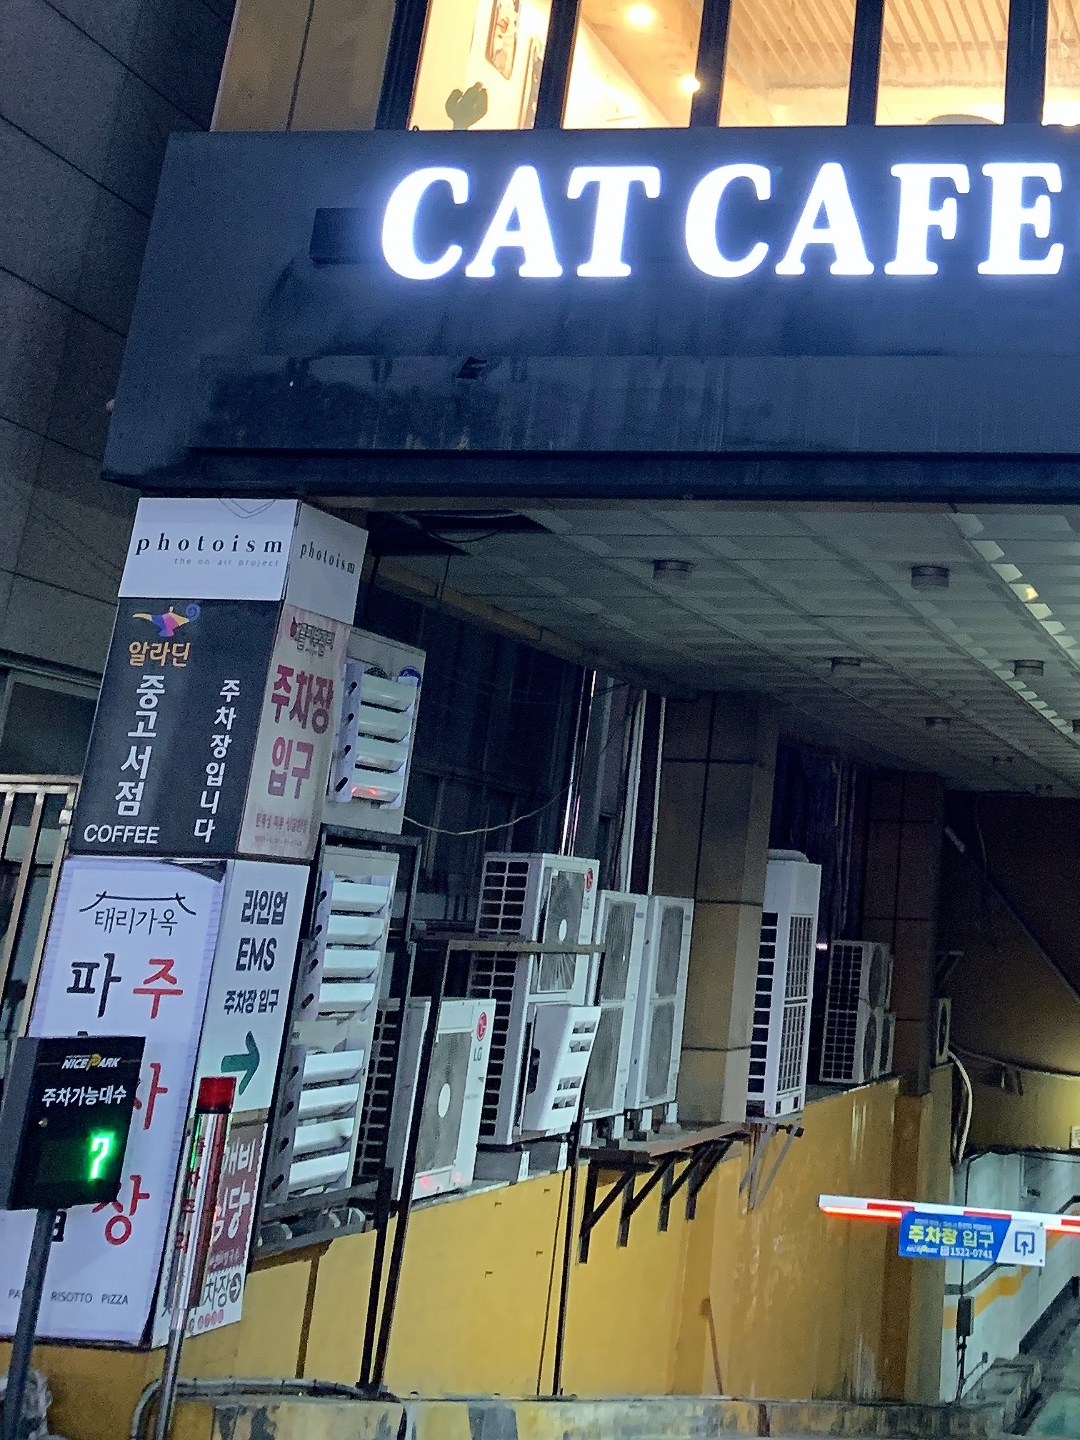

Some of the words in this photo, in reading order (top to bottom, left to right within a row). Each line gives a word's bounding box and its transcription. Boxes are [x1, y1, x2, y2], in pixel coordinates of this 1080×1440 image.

[381, 165, 661, 280] CAT
[685, 162, 1064, 278] CAFE
[135, 533, 283, 555] photoism
[300, 542, 355, 574] photoism
[128, 641, 191, 668] 알라딘
[271, 665, 334, 734] 주차장
[115, 675, 165, 817] 중고서점
[194, 680, 240, 843] 주차장입니다
[267, 736, 314, 799] 입구
[84, 824, 160, 844] COFFEE
[94, 907, 178, 937] 태리가옥
[240, 890, 288, 926] 라인업
[235, 937, 277, 972] EMS
[223, 990, 256, 1015] 주차장
[258, 989, 279, 1012] 입구
[473, 1046, 483, 1062] LG
[41, 1085, 127, 1108] 주차가능대수
[90, 1136, 111, 1179] 7
[962, 1229, 995, 1249] 입구
[50, 1291, 93, 1303] RISOTTO
[101, 1294, 129, 1305] PIZZA
